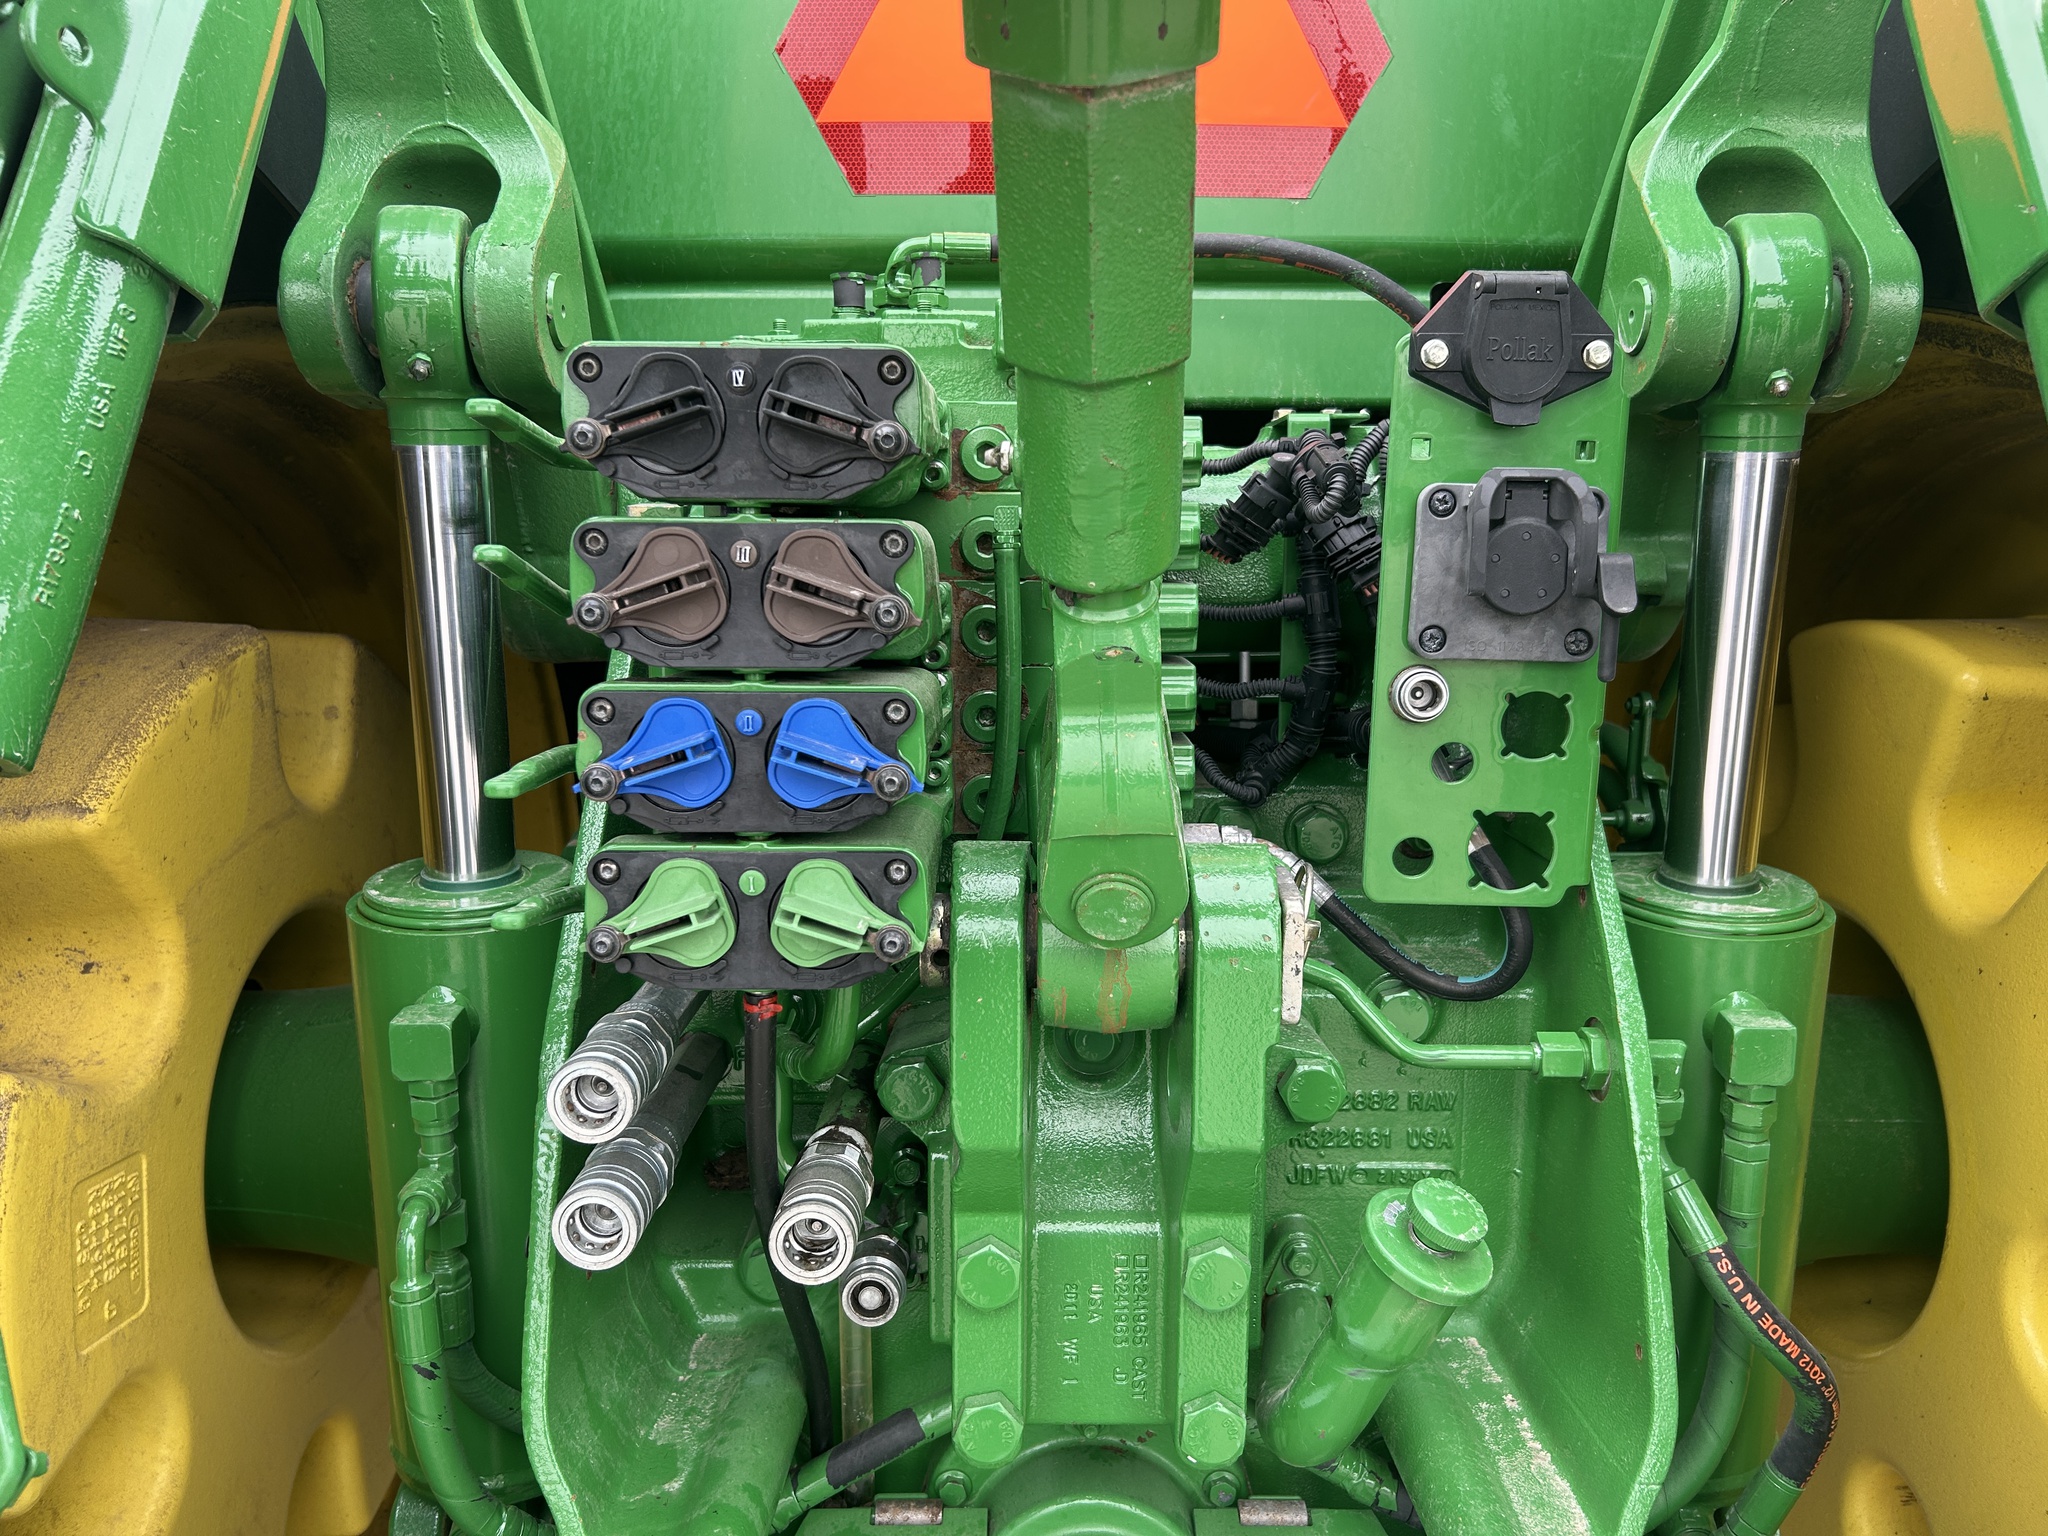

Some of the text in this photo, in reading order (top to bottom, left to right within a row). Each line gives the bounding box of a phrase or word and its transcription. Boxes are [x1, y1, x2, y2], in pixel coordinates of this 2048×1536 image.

[1485, 336, 1555, 363] Pollak
[731, 369, 745, 387] IV
[85, 382, 117, 430] USA
[1407, 1089, 1457, 1111] RAW
[1407, 1126, 1451, 1149] USA
[1286, 1162, 1348, 1185] JDFW
[1087, 1283, 1105, 1324] USA
[1740, 1292, 1762, 1315] IN
[1131, 1269, 1150, 1402] R241965 CAST
[1758, 1312, 1802, 1360] MADE
[1798, 1356, 1826, 1385] 2Q12
